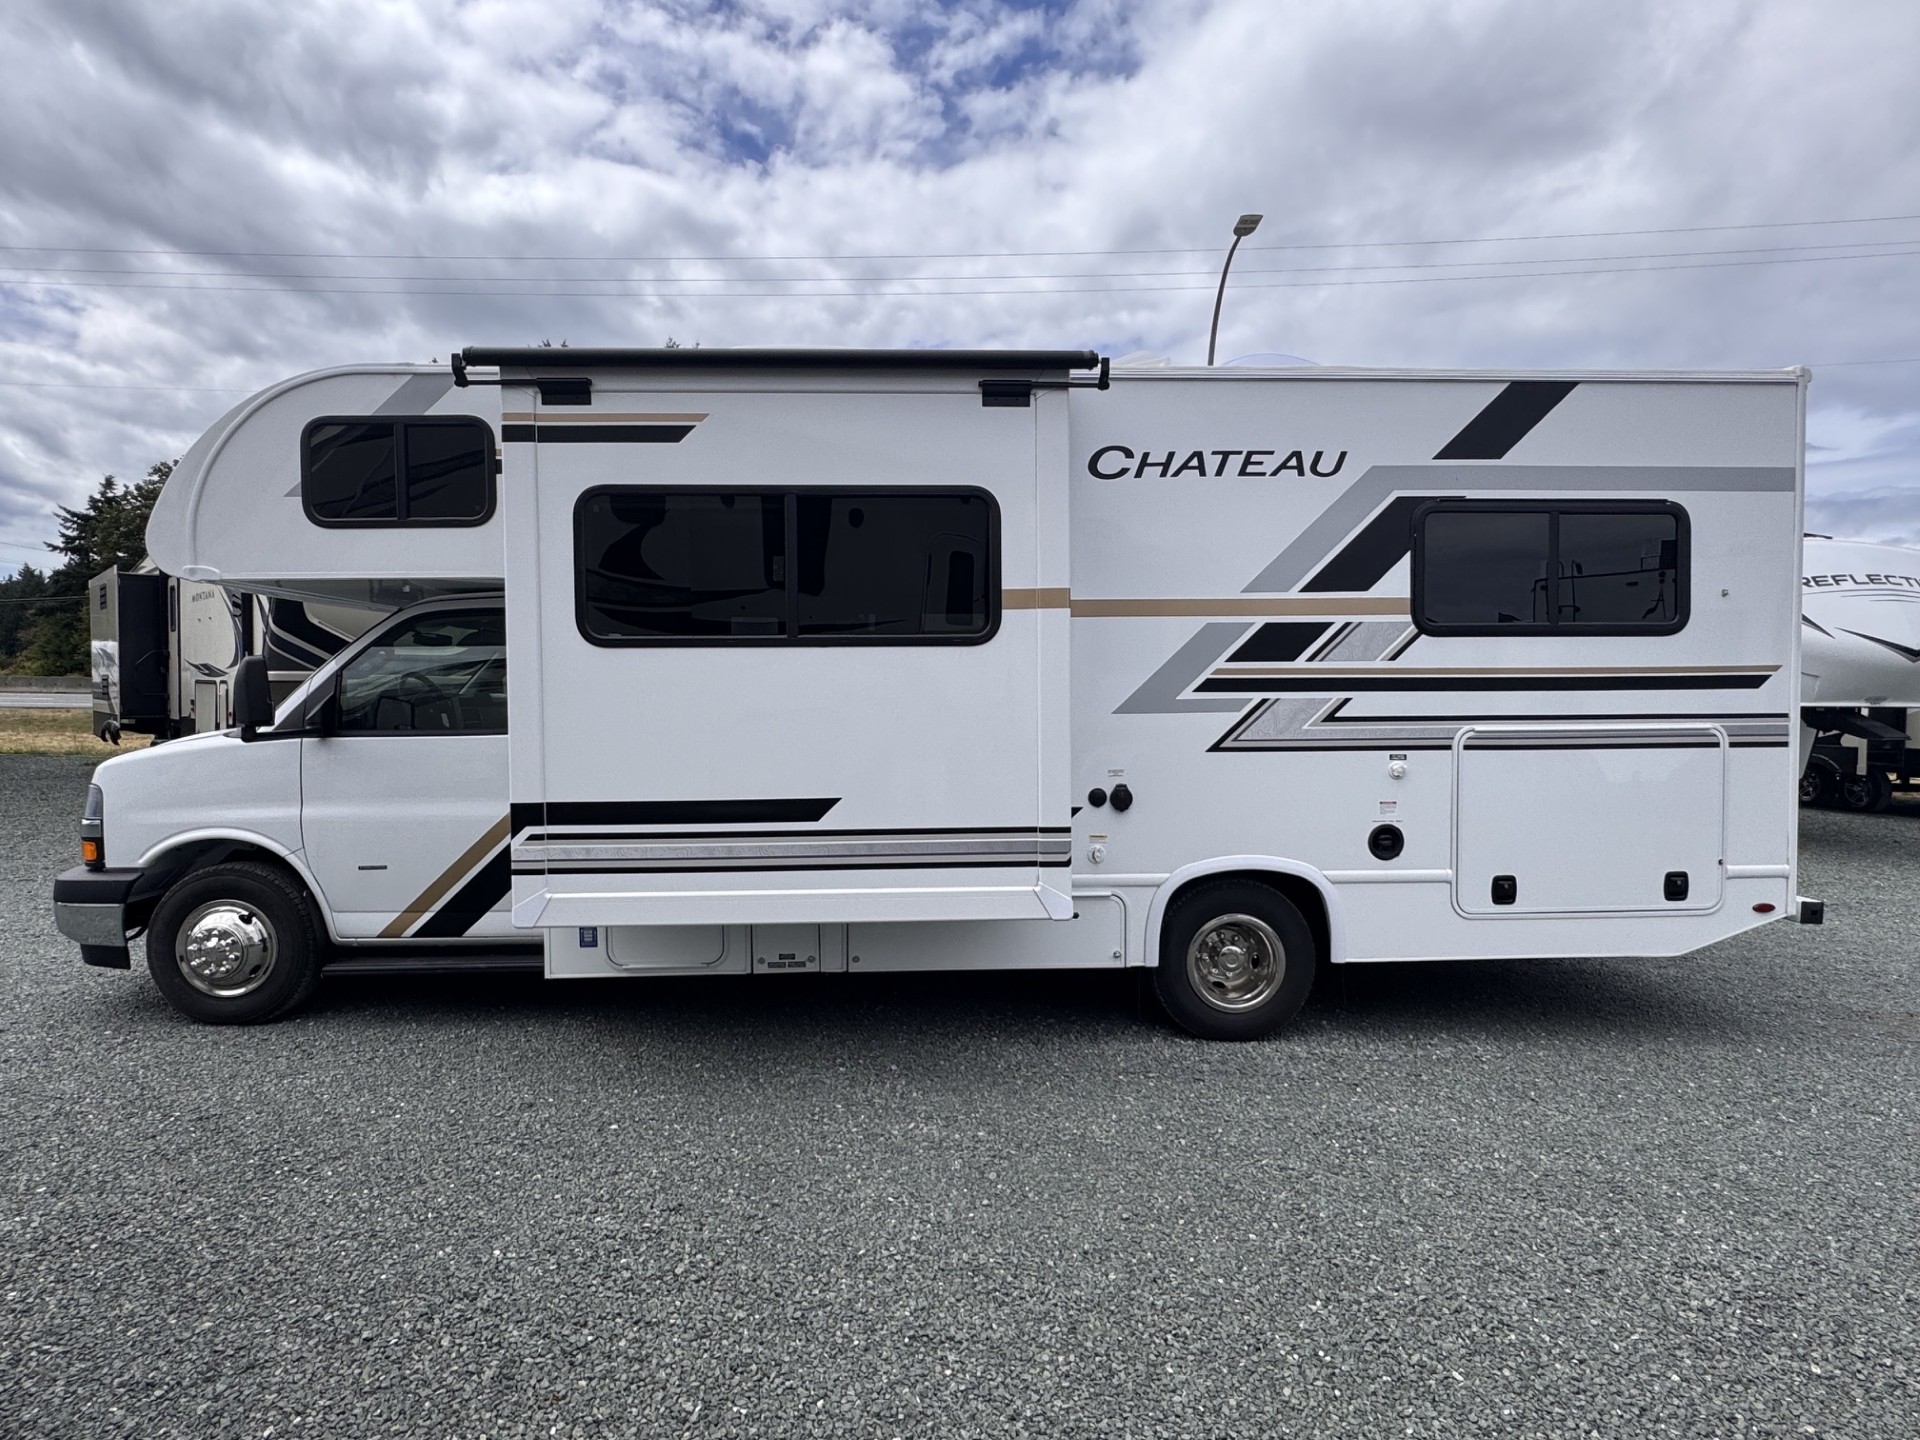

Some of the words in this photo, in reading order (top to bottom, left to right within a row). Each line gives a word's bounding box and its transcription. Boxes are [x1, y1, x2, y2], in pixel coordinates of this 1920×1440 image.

[1087, 445, 1348, 480] CHATEAU
[1802, 573, 1920, 588] REFLECTI
[191, 589, 215, 603] MONTANA
